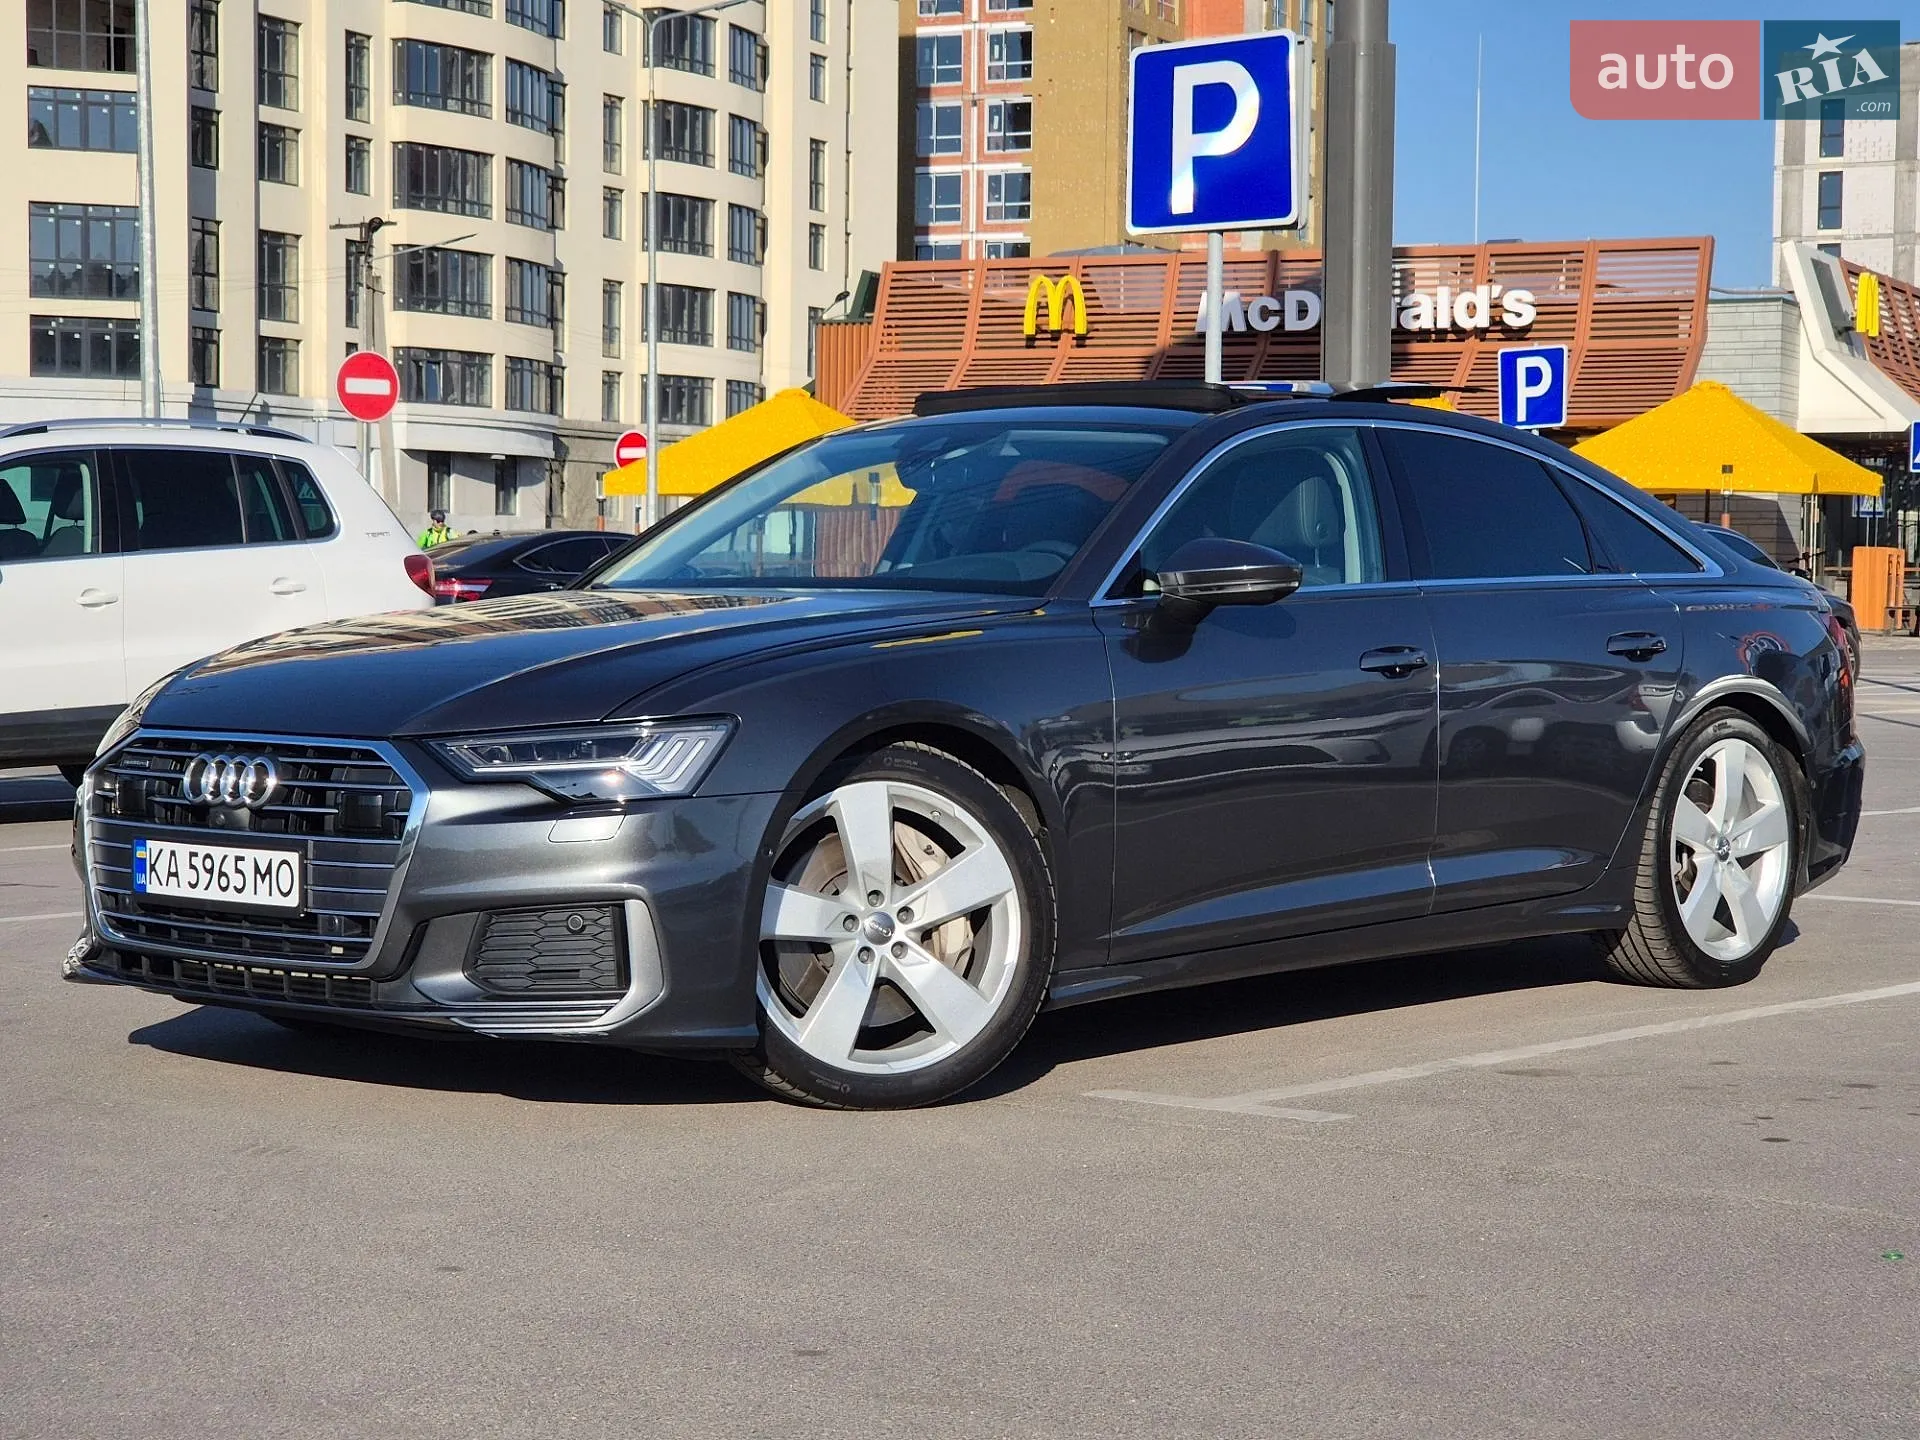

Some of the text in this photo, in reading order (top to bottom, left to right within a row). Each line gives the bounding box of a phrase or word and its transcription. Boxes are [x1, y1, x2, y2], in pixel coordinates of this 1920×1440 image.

[1171, 59, 1261, 216] P
[1194, 284, 1537, 333] McDald's
[1516, 355, 1553, 423] P
[136, 872, 147, 885] UA
[149, 847, 295, 898] KA 5965 MO
